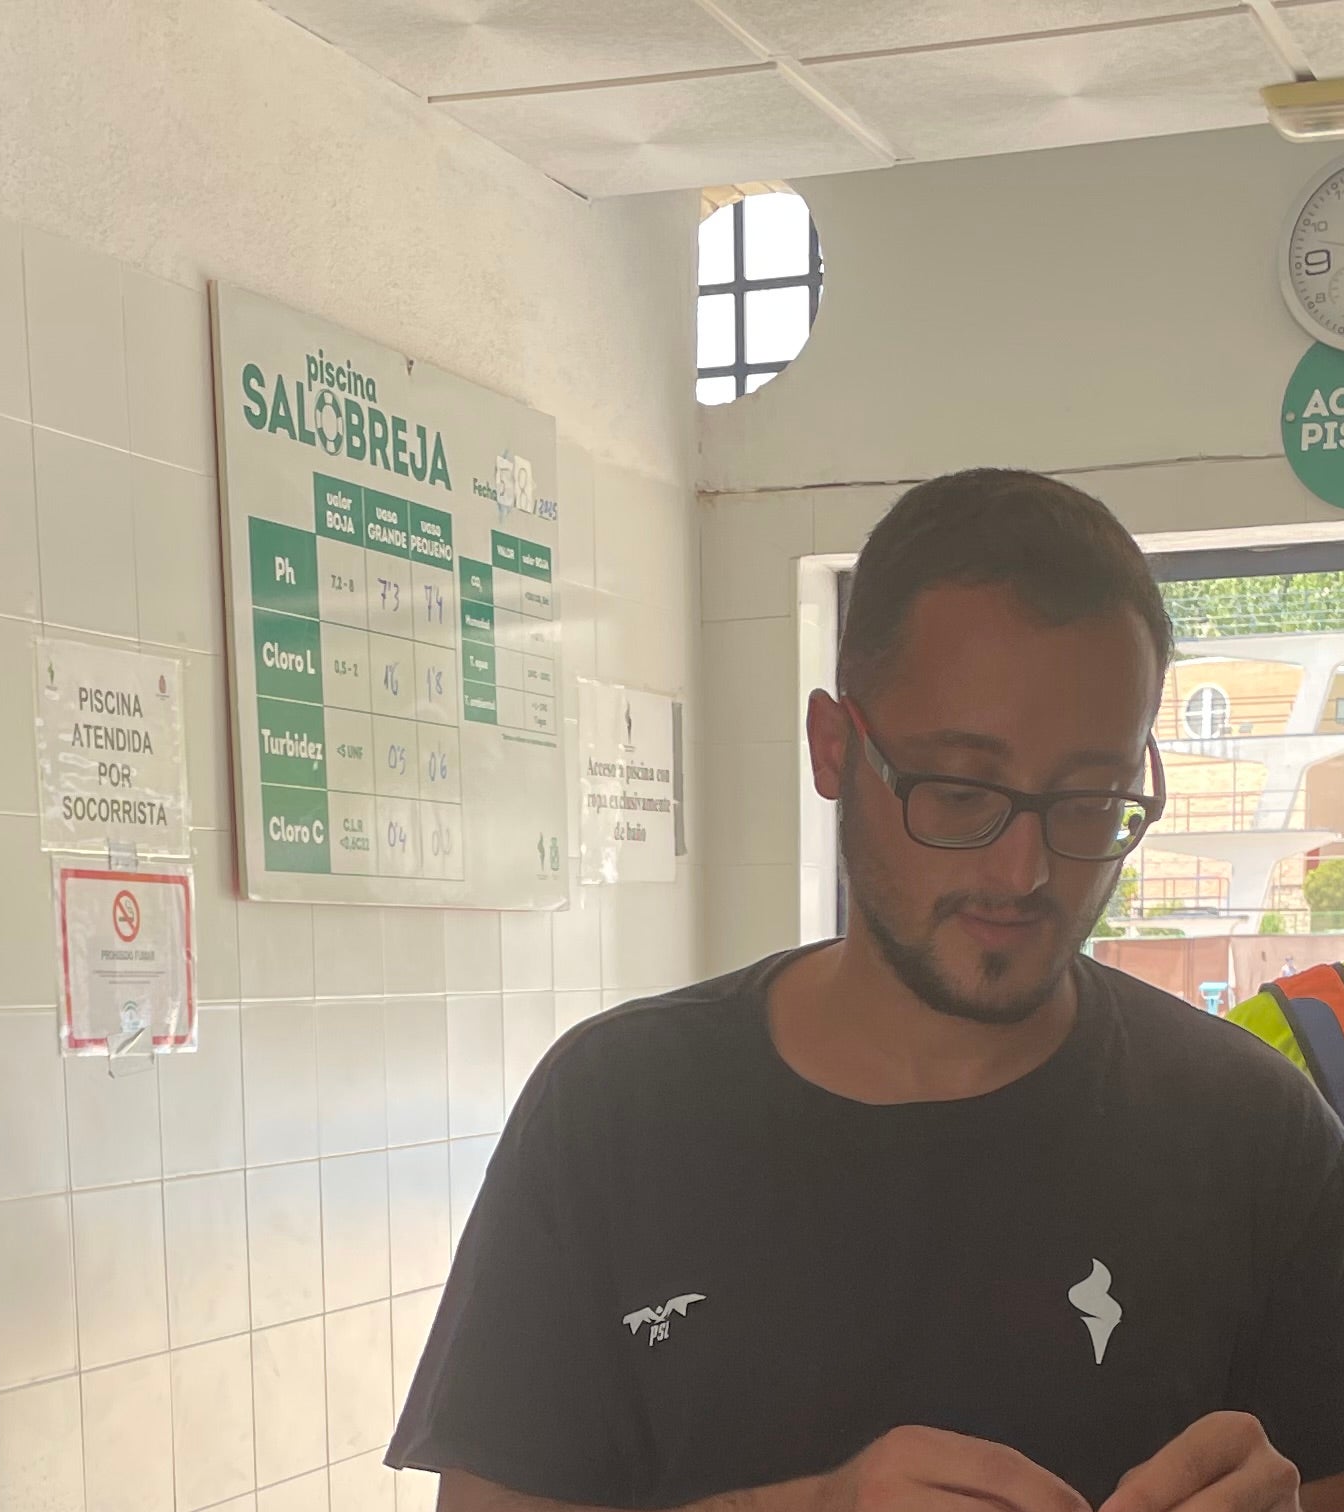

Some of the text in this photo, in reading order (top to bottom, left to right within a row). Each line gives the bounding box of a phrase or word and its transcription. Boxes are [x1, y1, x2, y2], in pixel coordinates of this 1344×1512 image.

[1312, 220, 1327, 232] 10
[1305, 249, 1331, 276] 9
[1316, 292, 1326, 303] 8
[306, 349, 377, 403] piscina
[242, 363, 452, 491] SALOBREJA
[326, 491, 353, 511] valor
[326, 511, 355, 534] BOJA
[376, 506, 398, 525] vaso
[420, 520, 441, 537] vaso
[367, 522, 407, 549] GRANDE
[410, 534, 452, 561] PEQUEÑO
[274, 556, 296, 585] Ph
[262, 641, 315, 675] Cloro L
[78, 687, 144, 718] PISCINA
[71, 723, 154, 755] ATENDIDA
[261, 728, 323, 761] Turbidez
[98, 762, 132, 788] POR
[587, 756, 616, 778] Acceso
[625, 760, 654, 784] piscina
[657, 768, 669, 783] con
[62, 796, 167, 826] SOCORRISTA
[587, 790, 670, 814] ropa exclusivamente
[269, 816, 325, 845] Cloro C
[614, 821, 646, 842] de baño
[649, 1320, 670, 1347] PSL
